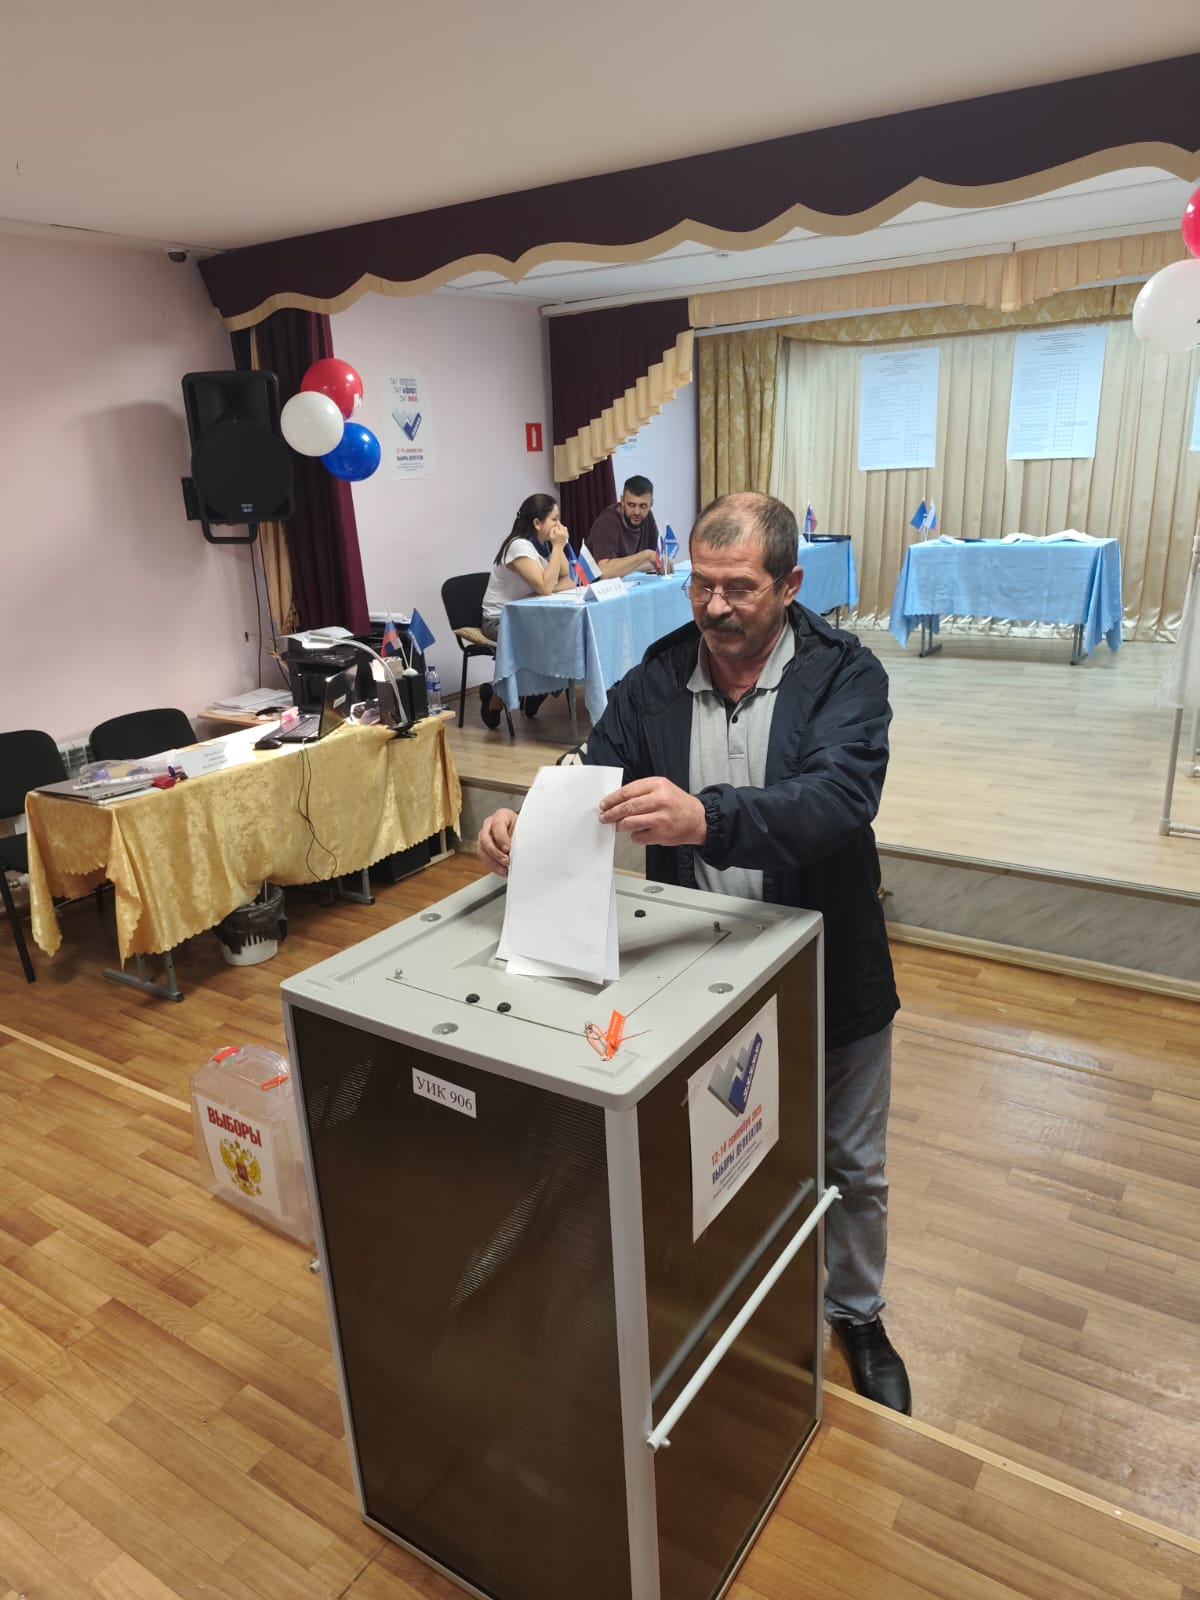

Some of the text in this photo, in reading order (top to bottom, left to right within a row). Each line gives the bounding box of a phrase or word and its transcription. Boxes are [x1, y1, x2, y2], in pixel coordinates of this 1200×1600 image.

[416, 1076, 473, 1111] УИК 906
[206, 1105, 263, 1148] ВЫБОРЫ
[711, 1148, 735, 1185] ВЫБОРЫ
